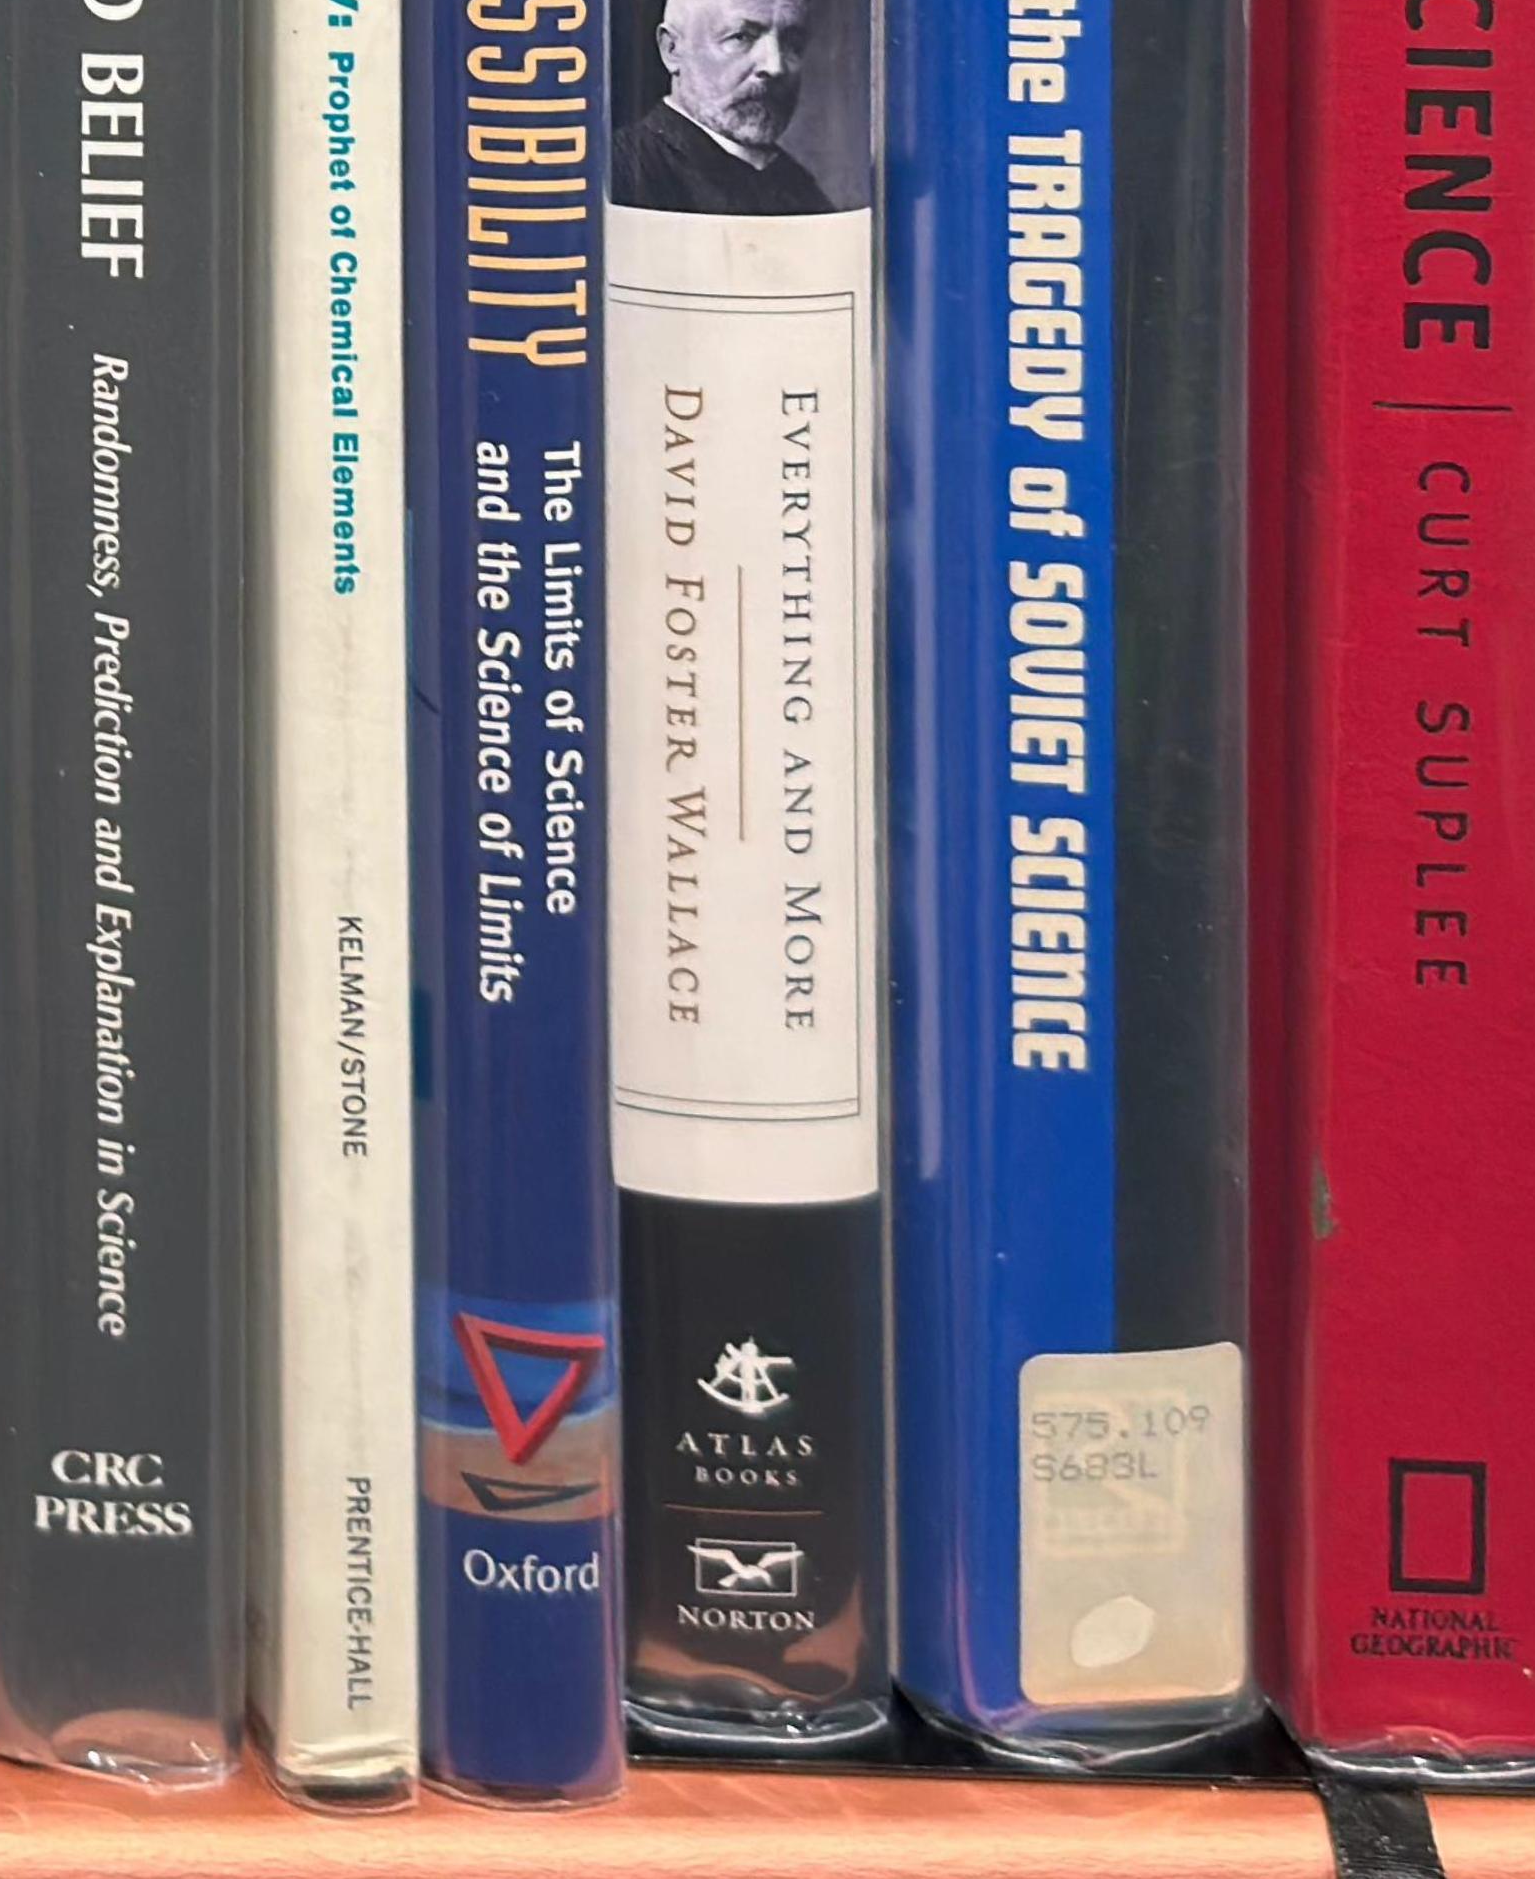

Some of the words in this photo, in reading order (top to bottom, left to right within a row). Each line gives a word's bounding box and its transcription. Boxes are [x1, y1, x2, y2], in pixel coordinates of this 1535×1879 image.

[81, 52, 147, 281] BELIEF
[323, 51, 358, 189] Prophet
[327, 253, 358, 418] Chemical
[1006, 128, 1083, 455] TRAGEDY
[87, 350, 128, 605] Randomness,
[332, 432, 356, 596] Elements
[663, 385, 704, 549] DAVID
[546, 535, 581, 678] Limits
[780, 385, 818, 726] EVERYTHING
[1416, 462, 1470, 649] CURT
[96, 611, 130, 802] Prediction
[475, 623, 520, 795] Science
[664, 576, 704, 775] FOSTER
[1010, 562, 1089, 795] SOVIET
[546, 748, 581, 916] Science
[664, 787, 708, 1028] WALLACE
[1416, 701, 1470, 988] SUPLEE
[87, 902, 136, 1124] Explanation
[475, 863, 517, 1004] Limits
[782, 883, 823, 1033] MORE
[336, 913, 365, 1156] KELMAN/STONE
[97, 1187, 135, 1339] Science
[34, 1496, 192, 1534] PRESS
[51, 1449, 162, 1486] CRC
[676, 1432, 816, 1461] ATLAS
[695, 1466, 799, 1488] BOOKS
[346, 1476, 373, 1709] PRENTICE-HALL
[461, 1548, 599, 1595] Oxford
[676, 1604, 816, 1634] NORTON
[1371, 1605, 1499, 1632] NATIONAL
